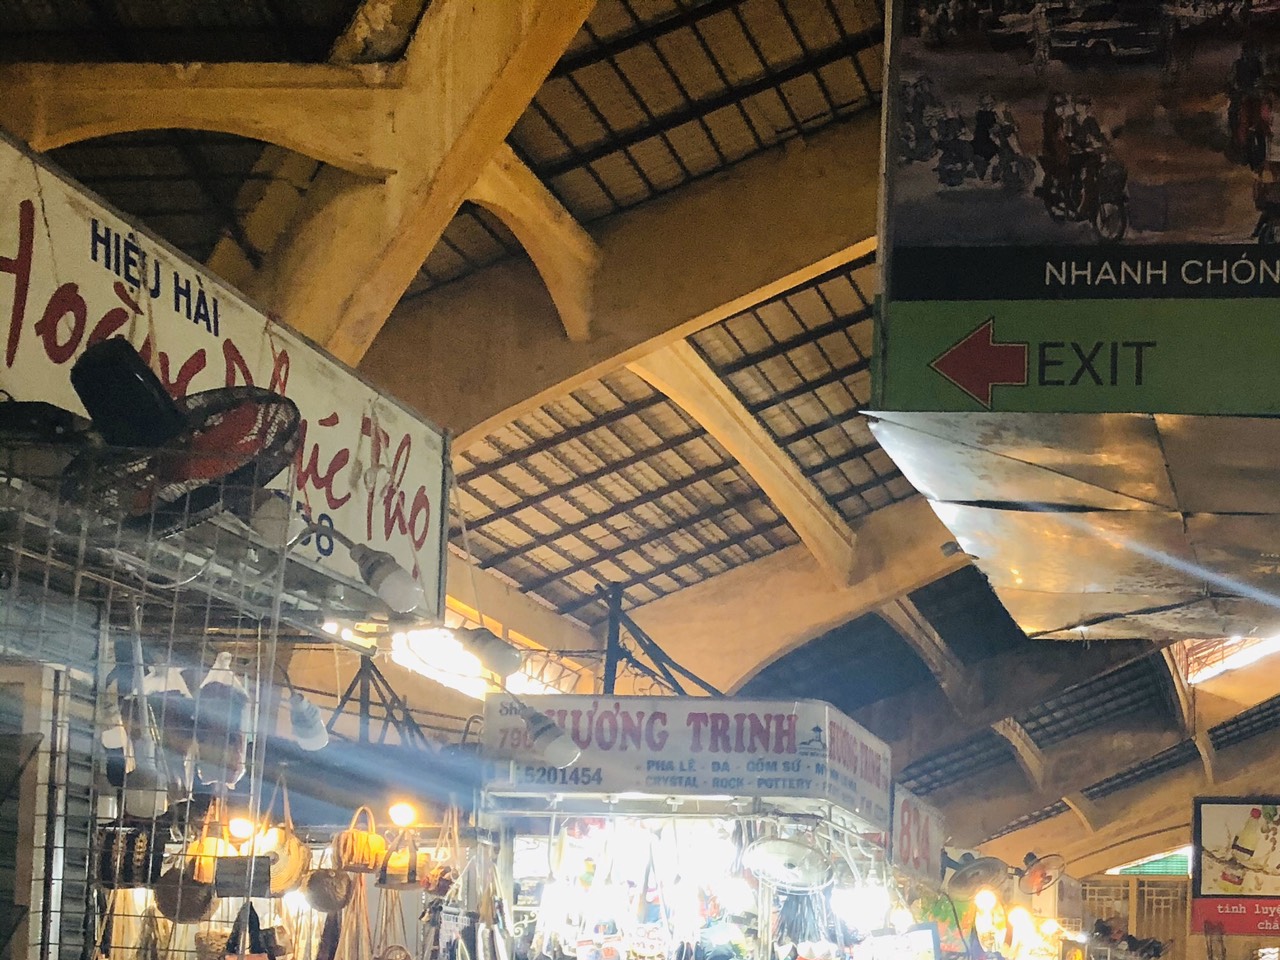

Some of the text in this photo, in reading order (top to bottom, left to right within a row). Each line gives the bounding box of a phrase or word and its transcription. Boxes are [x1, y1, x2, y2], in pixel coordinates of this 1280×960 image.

[90, 217, 221, 338] HIỆU HÀI
[1044, 260, 1168, 286] NHANH
[1037, 341, 1157, 387] EXIT
[685, 711, 800, 755] TRINH
[645, 775, 699, 788] CRYSTAL
[711, 776, 744, 790] ROCK
[756, 777, 812, 790] POTTERY
